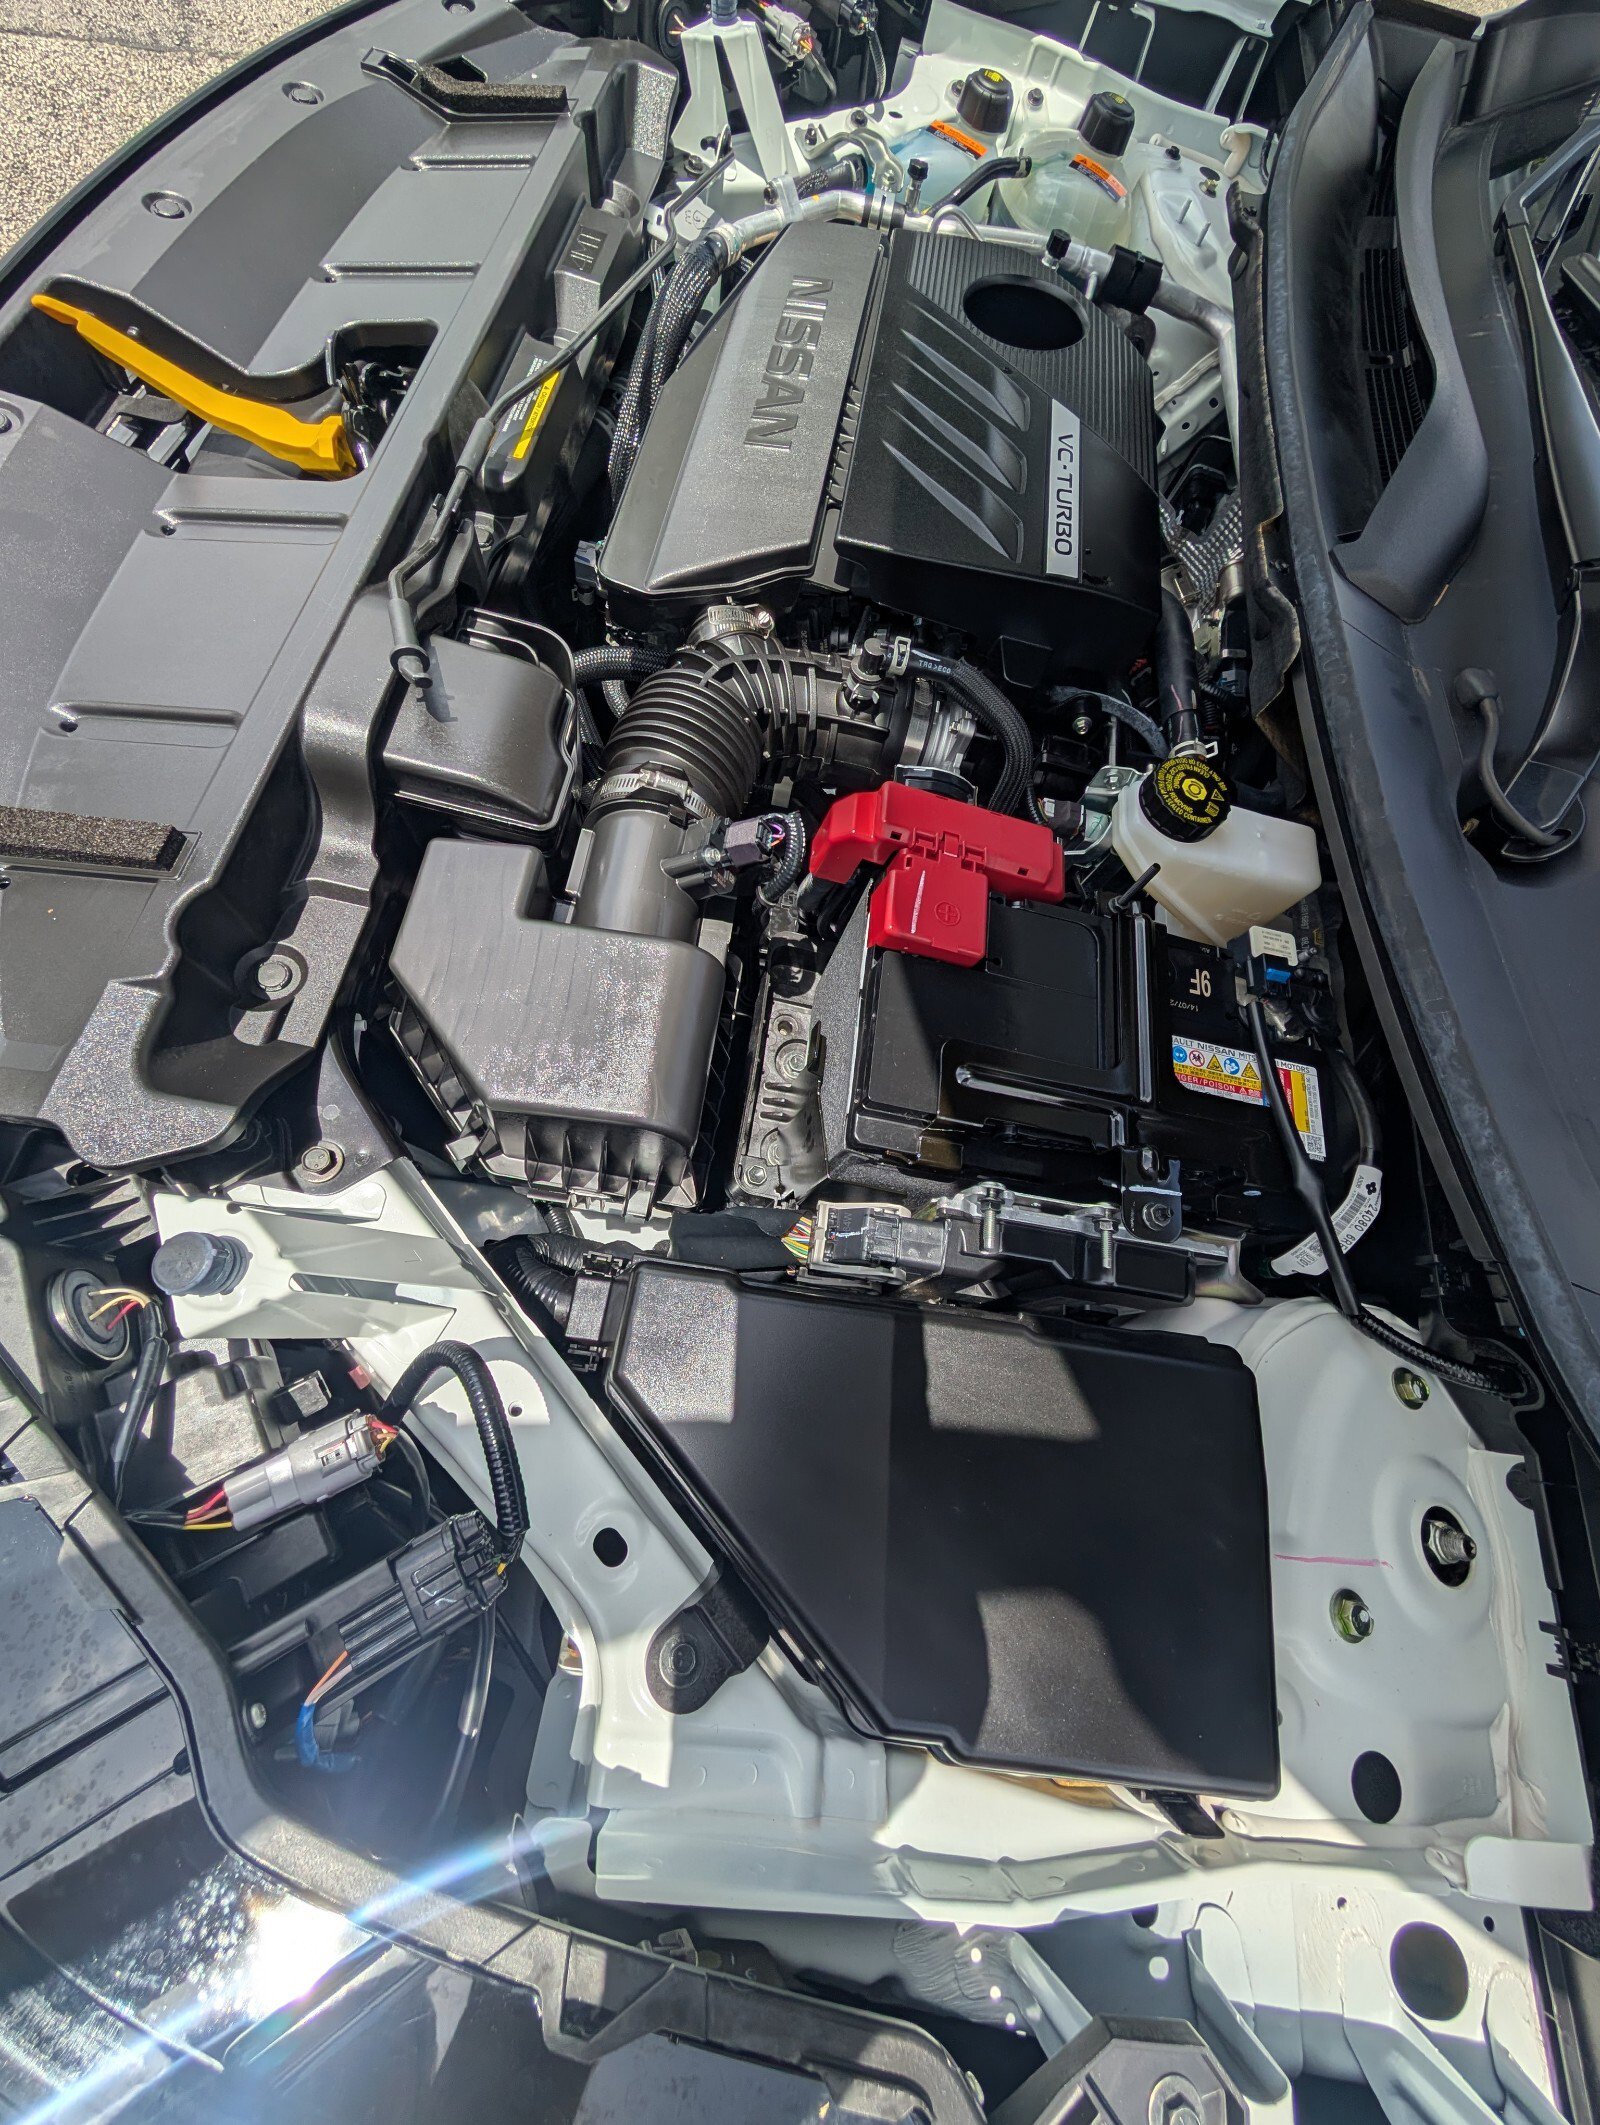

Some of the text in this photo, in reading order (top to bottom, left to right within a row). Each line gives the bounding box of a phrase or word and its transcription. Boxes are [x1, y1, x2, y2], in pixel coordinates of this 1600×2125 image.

[744, 275, 833, 451] NISSAN
[1194, 765, 1210, 778] CLEAN
[1165, 798, 1184, 815] SEALED
[1170, 791, 1193, 814] REMOVING
[1189, 968, 1212, 998] 9F
[1198, 1043, 1236, 1056] NISSAN
[1280, 1061, 1311, 1073] MOTORS
[1354, 1203, 1378, 1232] 24080
